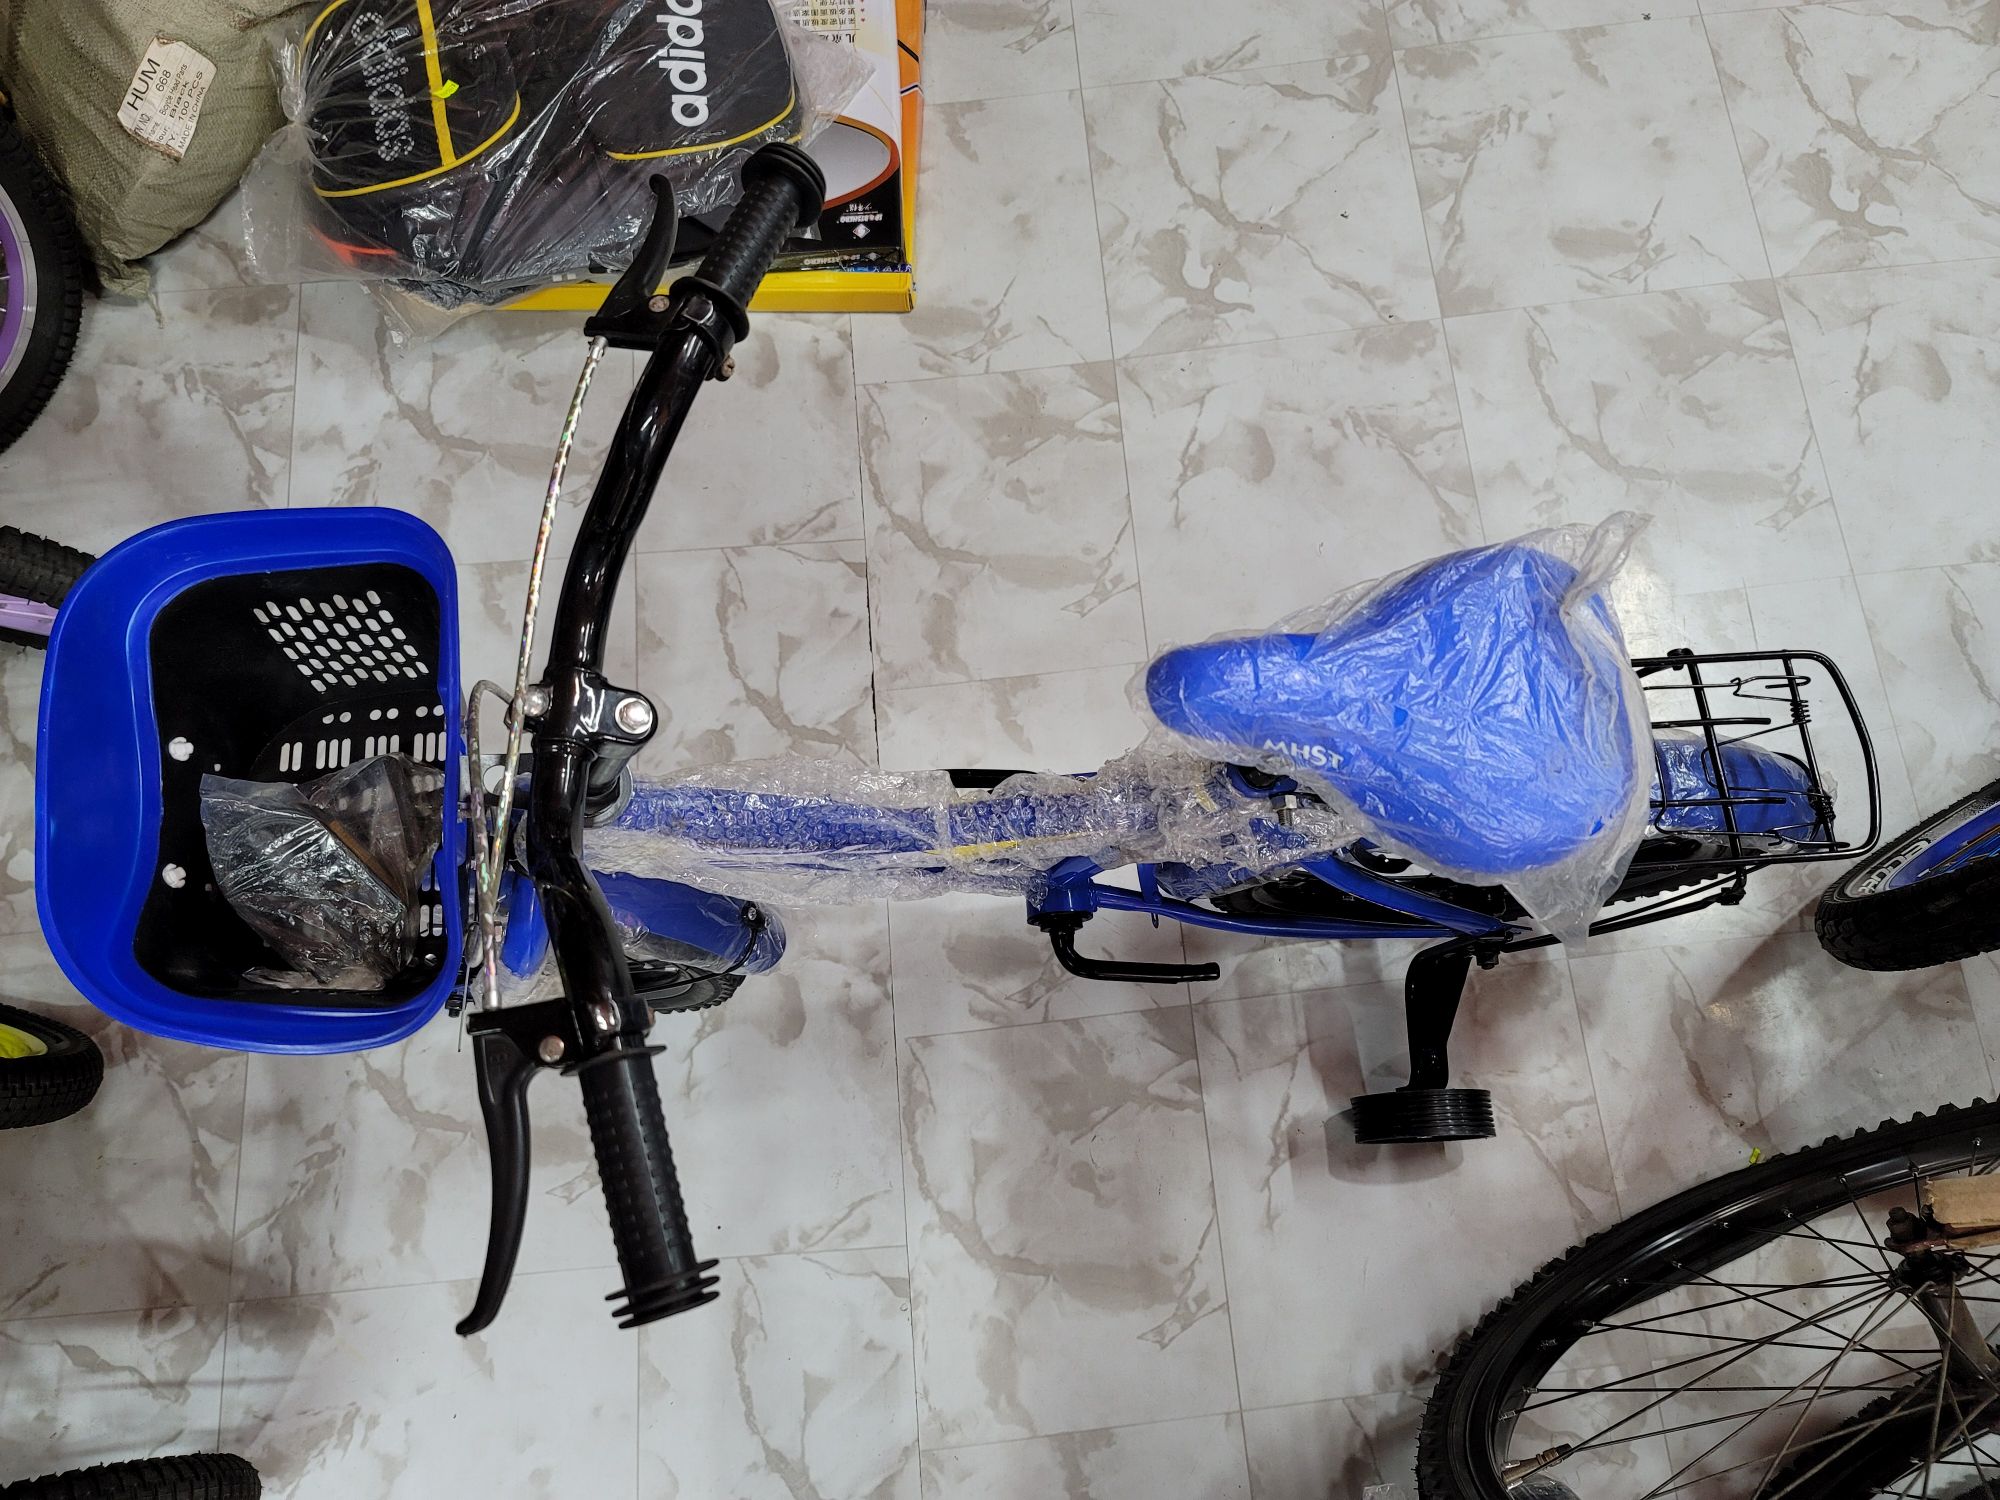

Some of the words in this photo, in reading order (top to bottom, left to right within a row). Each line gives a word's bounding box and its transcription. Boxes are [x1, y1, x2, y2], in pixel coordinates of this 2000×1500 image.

[127, 58, 160, 111] HUM
[156, 70, 171, 91] 668
[159, 95, 174, 116] Bicycle
[170, 80, 181, 96] Head
[176, 64, 188, 79] Parts
[179, 101, 190, 121] 100
[188, 71, 203, 98] PCS
[169, 81, 189, 118] Black
[192, 86, 206, 113] CHINA
[189, 113, 198, 124] IN
[178, 123, 193, 149] MADE
[1263, 738, 1344, 769] MHST
